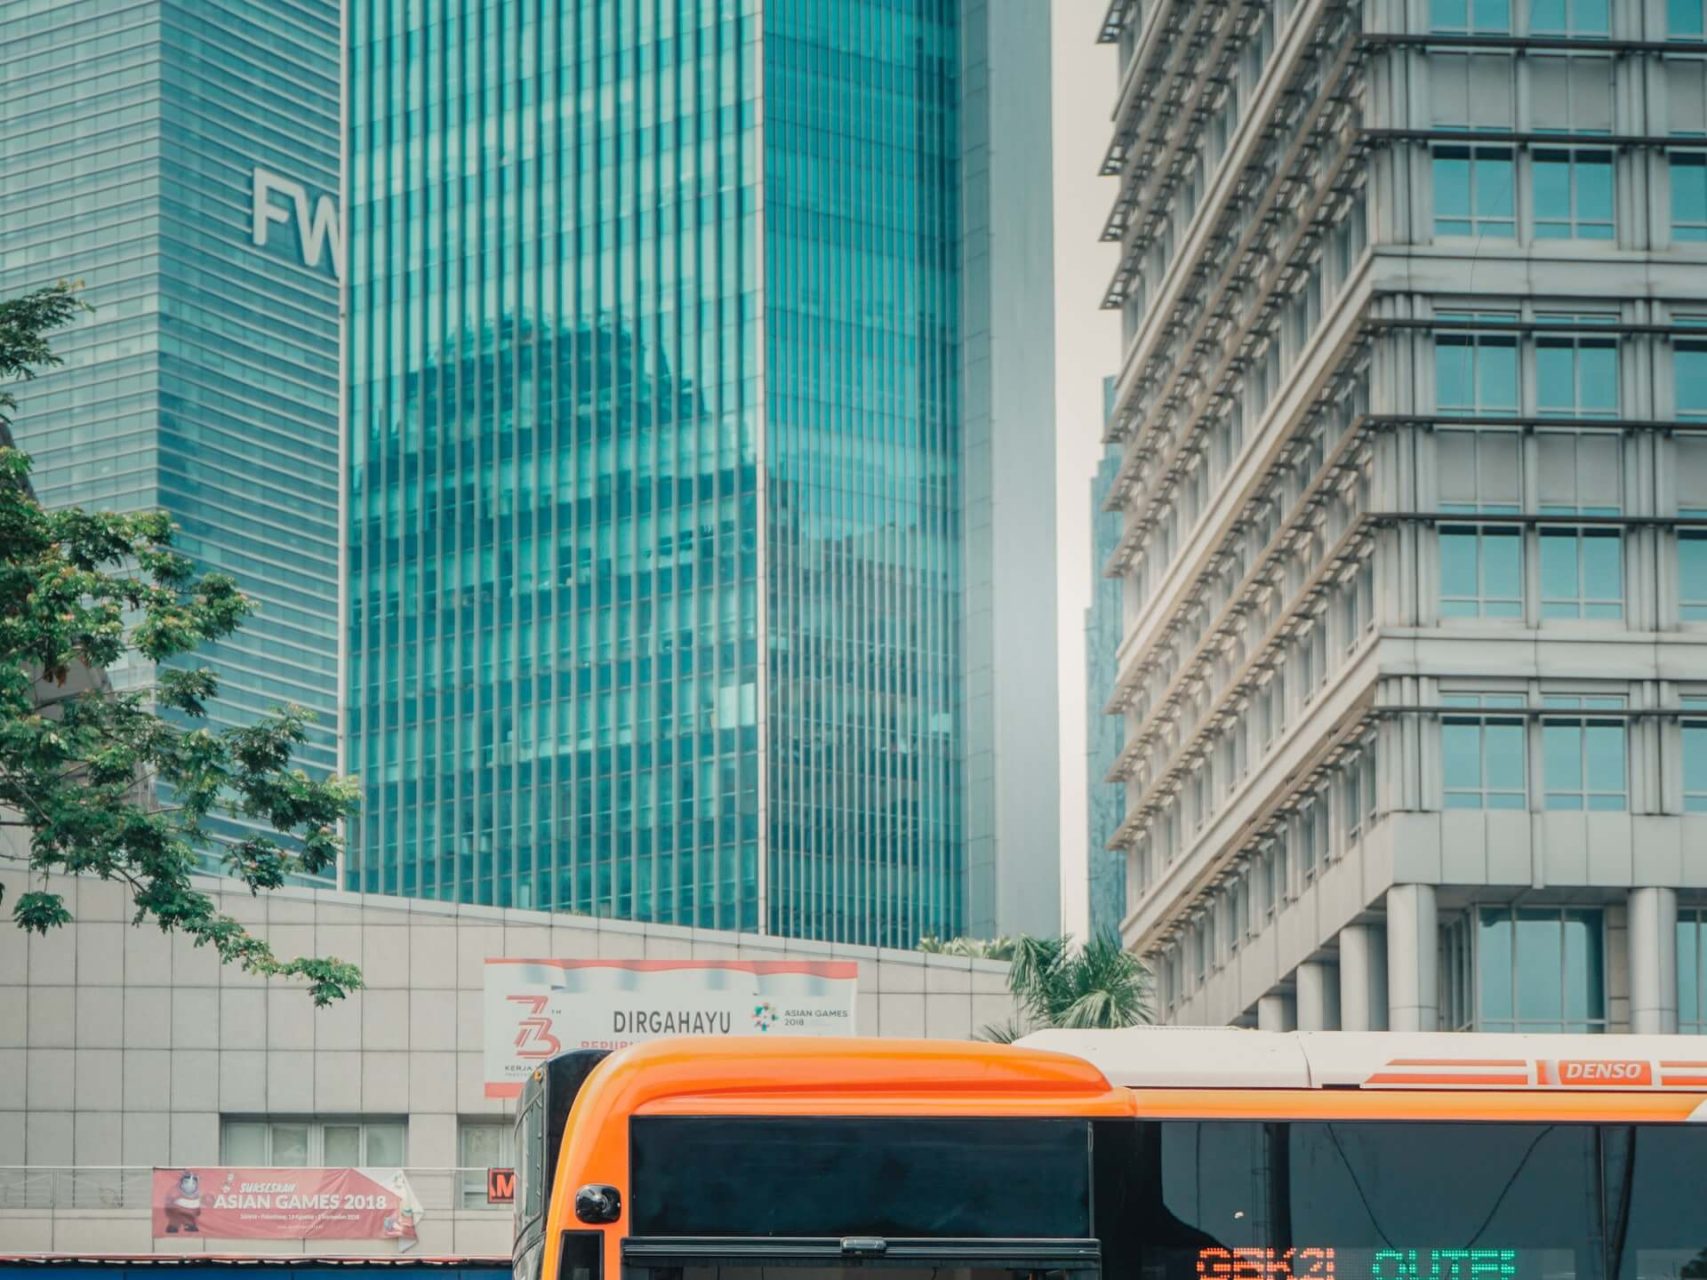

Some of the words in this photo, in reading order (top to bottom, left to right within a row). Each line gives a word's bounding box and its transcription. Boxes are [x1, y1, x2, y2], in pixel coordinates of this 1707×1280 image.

[815, 1010, 848, 1018] GAMES
[613, 1011, 731, 1034] DIRGAHAYU
[784, 1018, 804, 1026] 2018
[1566, 1063, 1642, 1078] DENSO
[213, 1194, 270, 1209] ASIAN
[276, 1194, 340, 1209] GAMES
[344, 1194, 388, 1209] 2018
